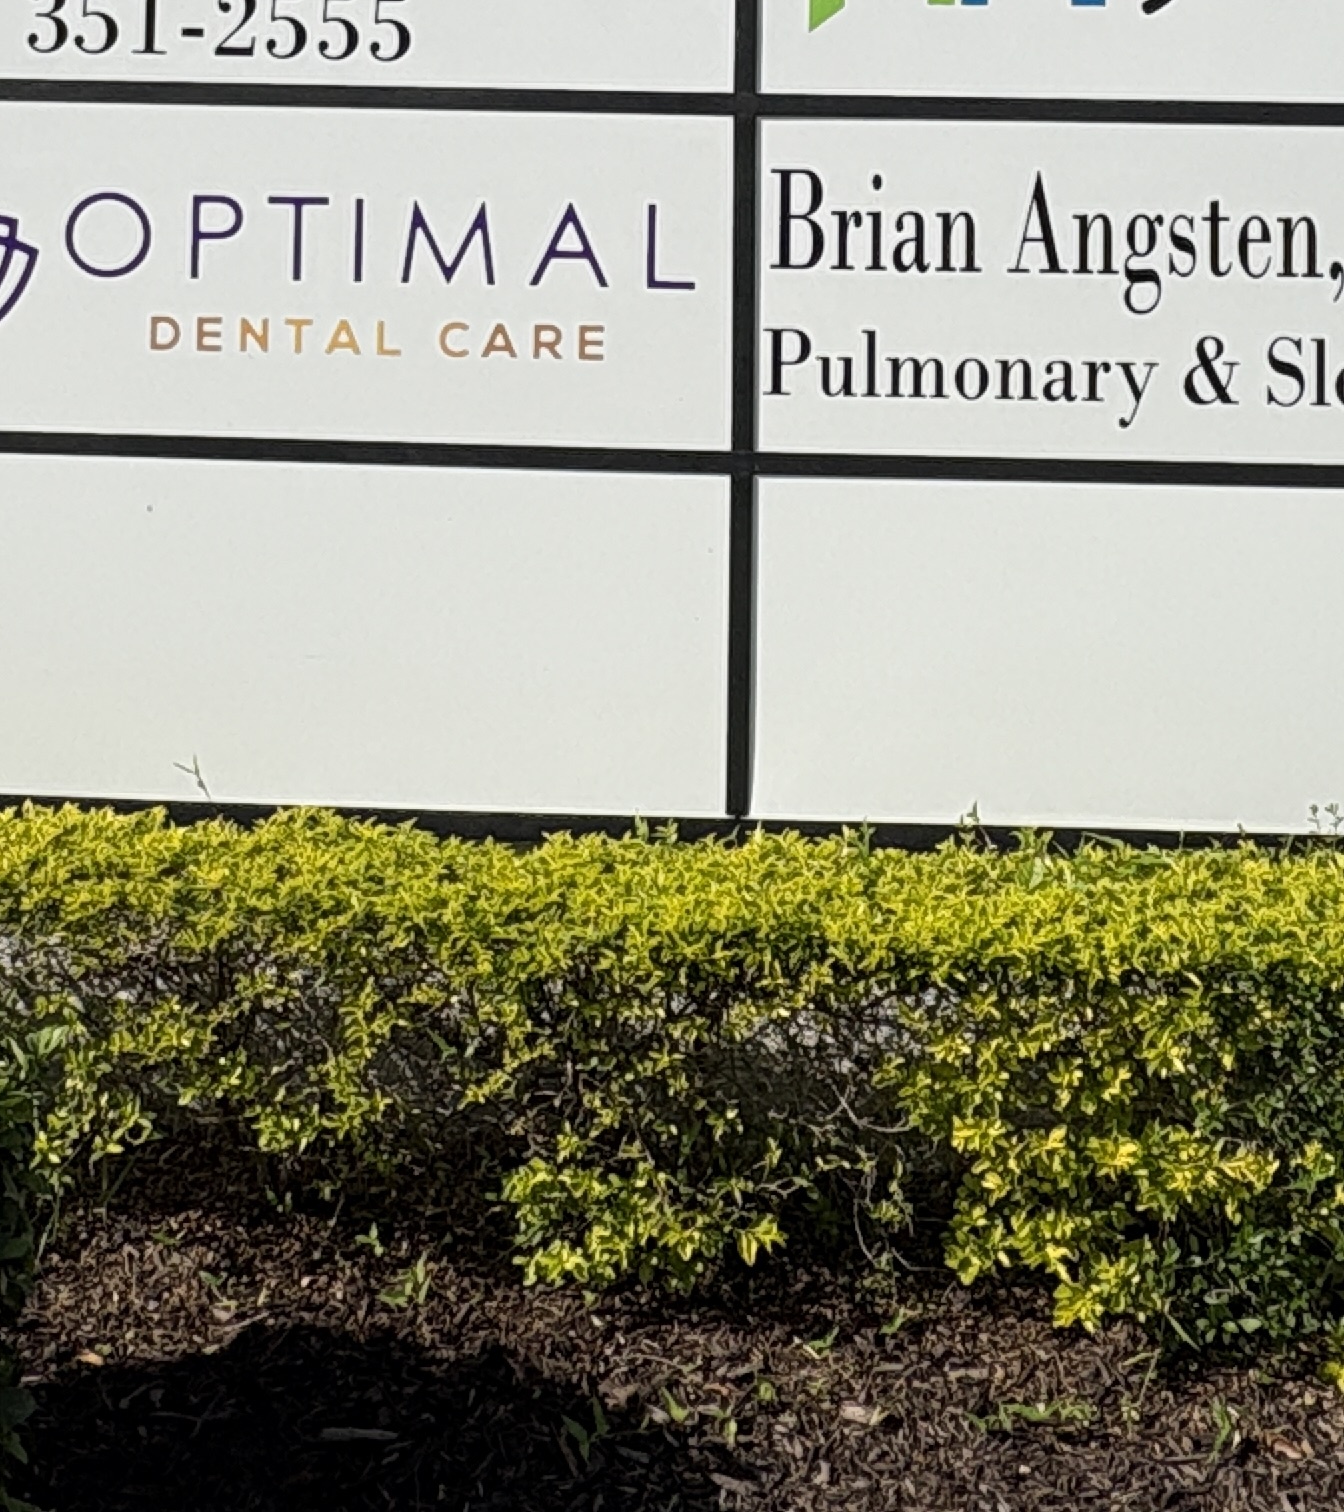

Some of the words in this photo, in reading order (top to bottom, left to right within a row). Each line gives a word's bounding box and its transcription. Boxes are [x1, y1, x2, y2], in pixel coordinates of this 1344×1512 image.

[64, 190, 697, 291] OPTIMAL
[769, 168, 982, 275] Brian
[150, 315, 402, 358] DENTAL
[439, 321, 606, 362] CARE
[762, 328, 1159, 427] Pulmonary
[1183, 335, 1242, 408] &
